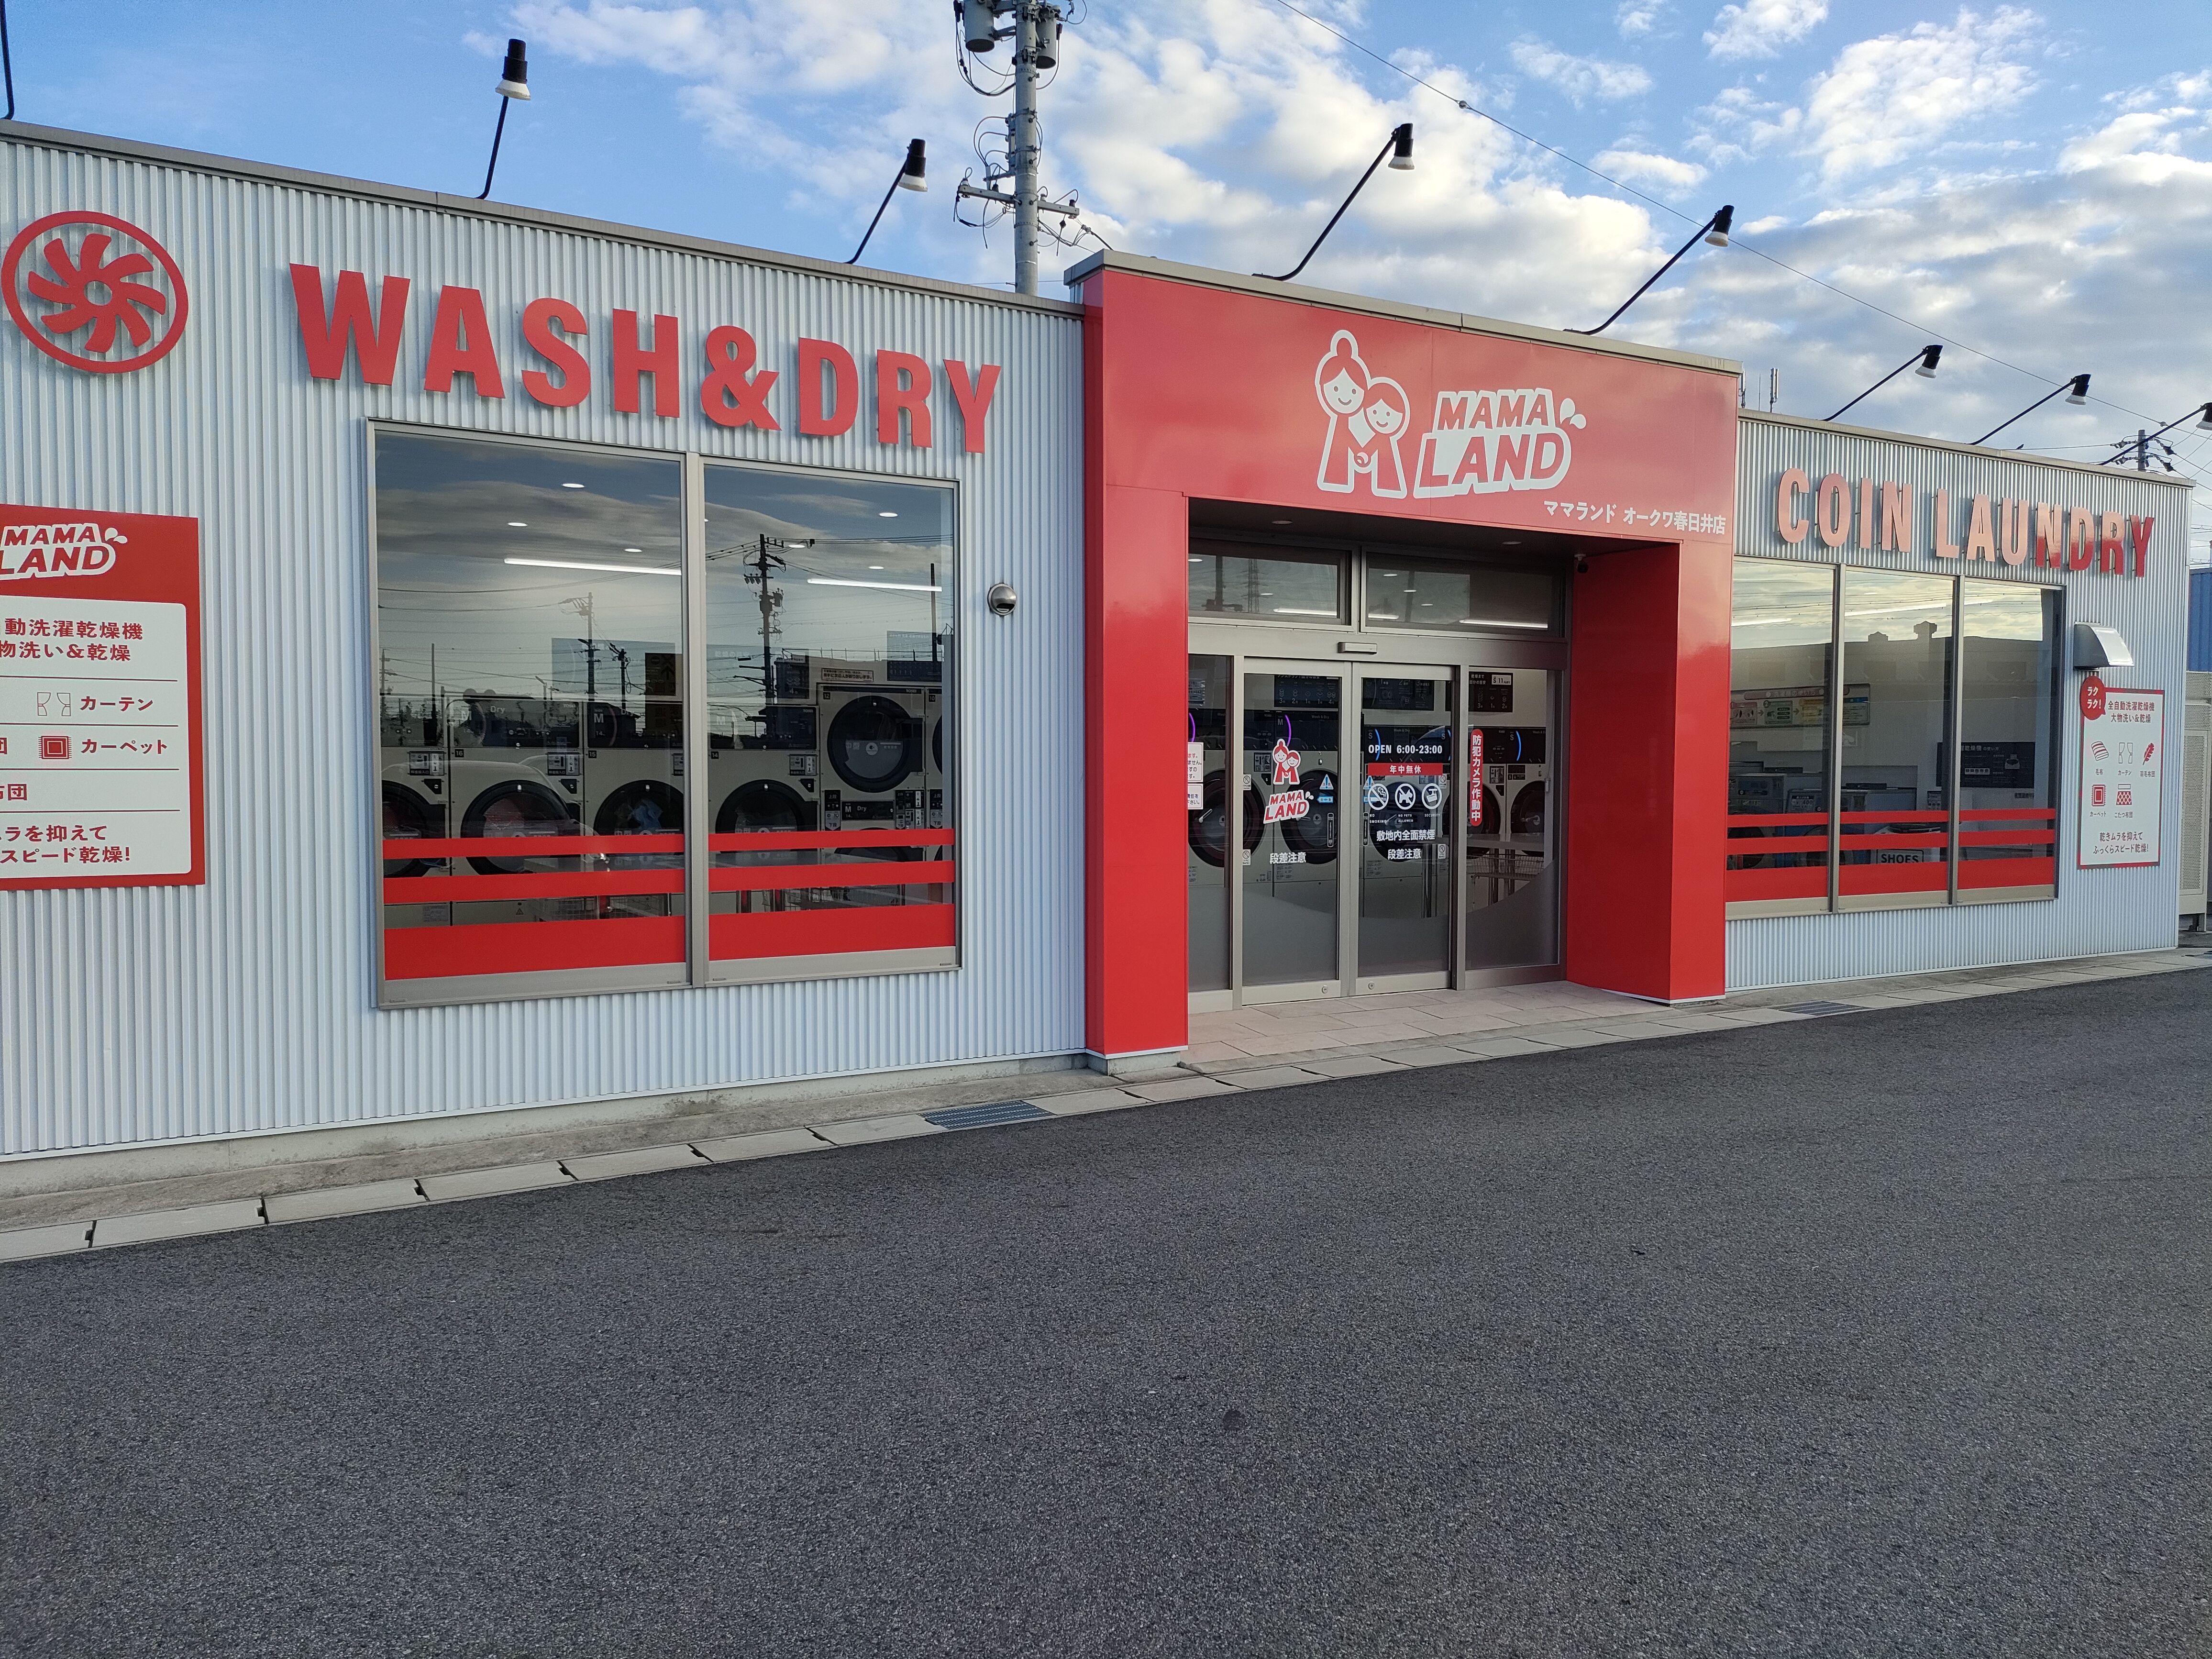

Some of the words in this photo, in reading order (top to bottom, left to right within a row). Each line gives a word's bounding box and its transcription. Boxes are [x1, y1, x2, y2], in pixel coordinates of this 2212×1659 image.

[289, 263, 1002, 454] WASH&DRY
[1437, 394, 1549, 431] MAMA
[1418, 432, 1568, 488] LAND
[1543, 500, 1617, 524] ママランド
[1624, 507, 1726, 535] オークワ春日井店
[1777, 467, 1912, 553] COIN
[1936, 487, 2155, 578] LAUNDRY
[3, 525, 97, 547] MAMA
[0, 545, 111, 575] LAND
[5, 618, 144, 640] 動洗濯乾燥機
[0, 640, 131, 662] 物洗い&乾燥
[2087, 686, 2099, 697] ラク
[80, 696, 154, 711] カーテン
[490, 706, 506, 714] Dry
[2087, 698, 2101, 709] ラク!
[2108, 700, 2155, 712] 全自動洗濯乾燥機
[593, 713, 604, 723] M
[2111, 713, 2151, 723] 大物洗い&乾燥
[81, 739, 168, 754] カーペット
[1368, 744, 1392, 754] OPEN
[1396, 744, 1442, 754] 6:00-23:00
[1389, 764, 1422, 774] 年中無休
[1471, 734, 1482, 822] 防犯カメラ作動中
[1269, 792, 1303, 806] MAMA
[1264, 800, 1308, 822] LAND
[0, 825, 108, 842] ラを抑えて
[1376, 829, 1436, 841] 敷地内全面禁煙
[2099, 831, 2143, 842] 乾きムラを抑えて
[1387, 848, 1422, 860] 段差注意
[2093, 843, 2149, 854] ふっくらスピード乾燥!
[1269, 852, 1307, 864] 段差注意
[1880, 853, 1919, 863] SHOES
